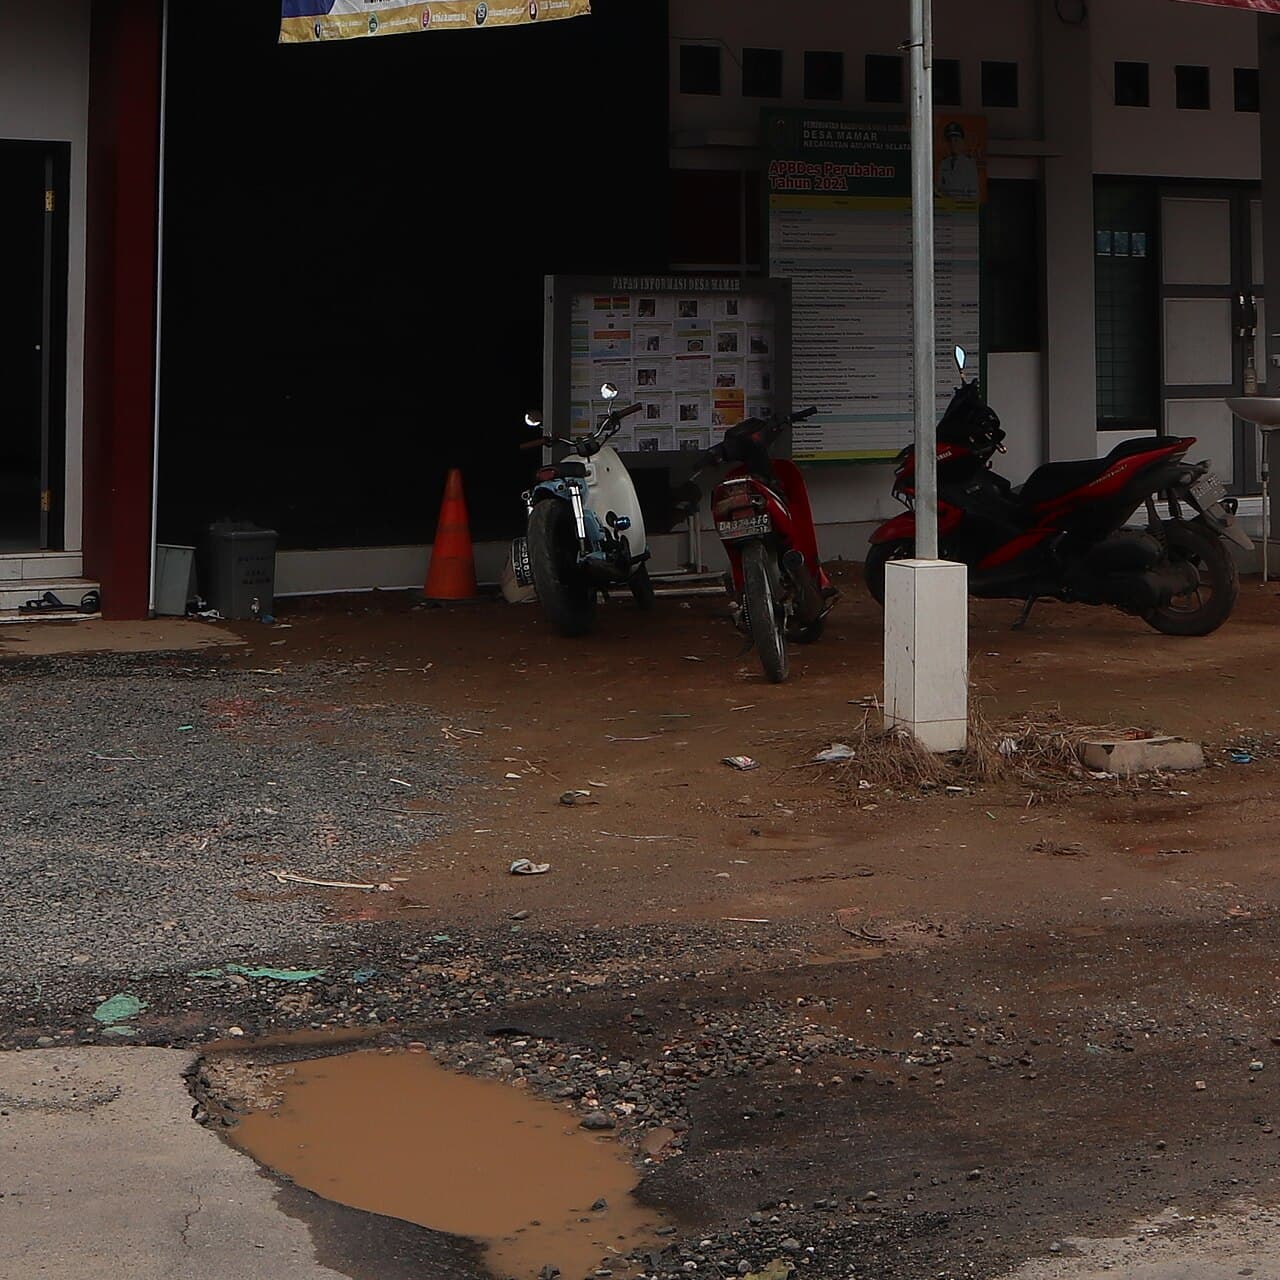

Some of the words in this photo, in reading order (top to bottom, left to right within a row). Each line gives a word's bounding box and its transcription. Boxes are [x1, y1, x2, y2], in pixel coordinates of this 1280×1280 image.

[803, 130, 833, 140] DESA
[837, 130, 878, 141] MAMAR
[769, 160, 820, 175] APBDes
[823, 162, 896, 177] Perubahan
[769, 176, 811, 190] Tahun
[814, 177, 848, 191] 2021
